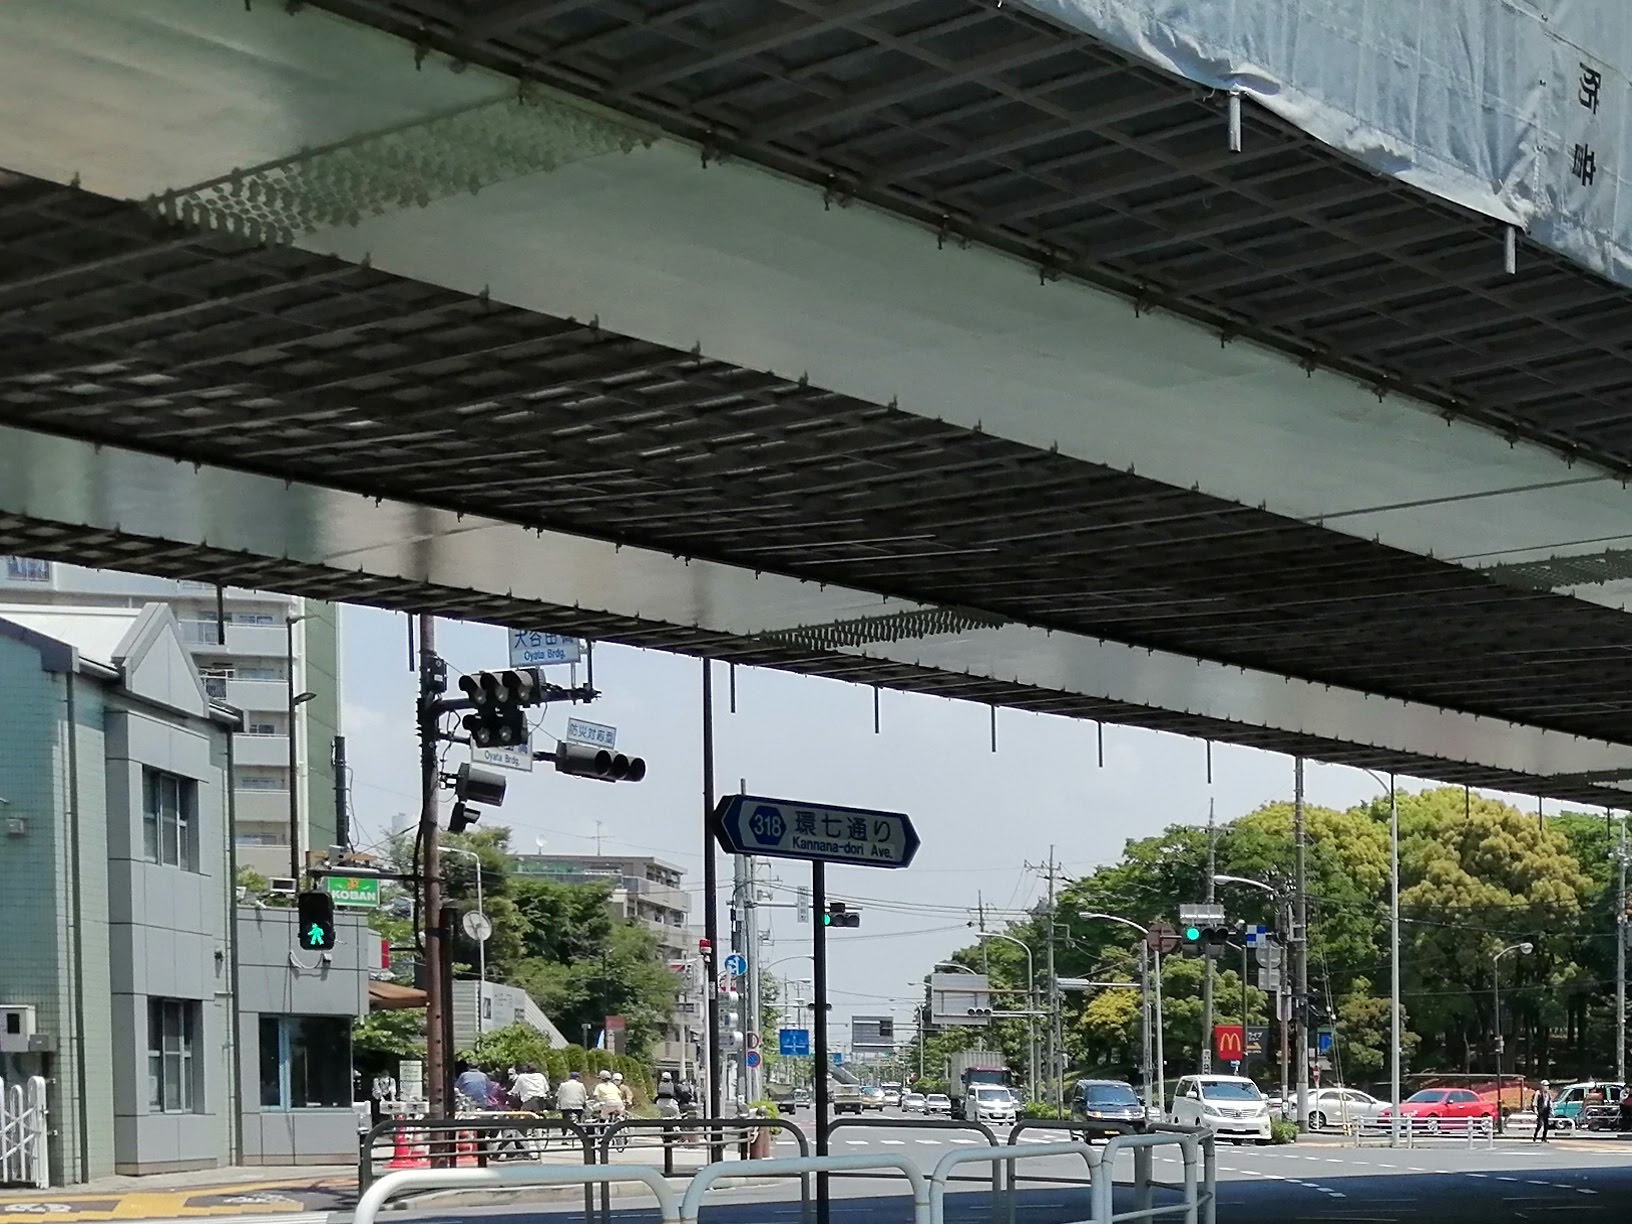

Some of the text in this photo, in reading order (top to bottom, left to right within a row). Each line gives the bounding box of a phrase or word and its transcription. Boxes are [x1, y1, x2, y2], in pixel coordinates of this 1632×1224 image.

[524, 648, 566, 662] Oyata Brdg.
[484, 750, 503, 762] Oyata
[754, 814, 782, 838] 318
[794, 811, 892, 843] 環七通り
[793, 835, 893, 859] Kannana-dori Ave.
[332, 890, 377, 900] KOBAN
